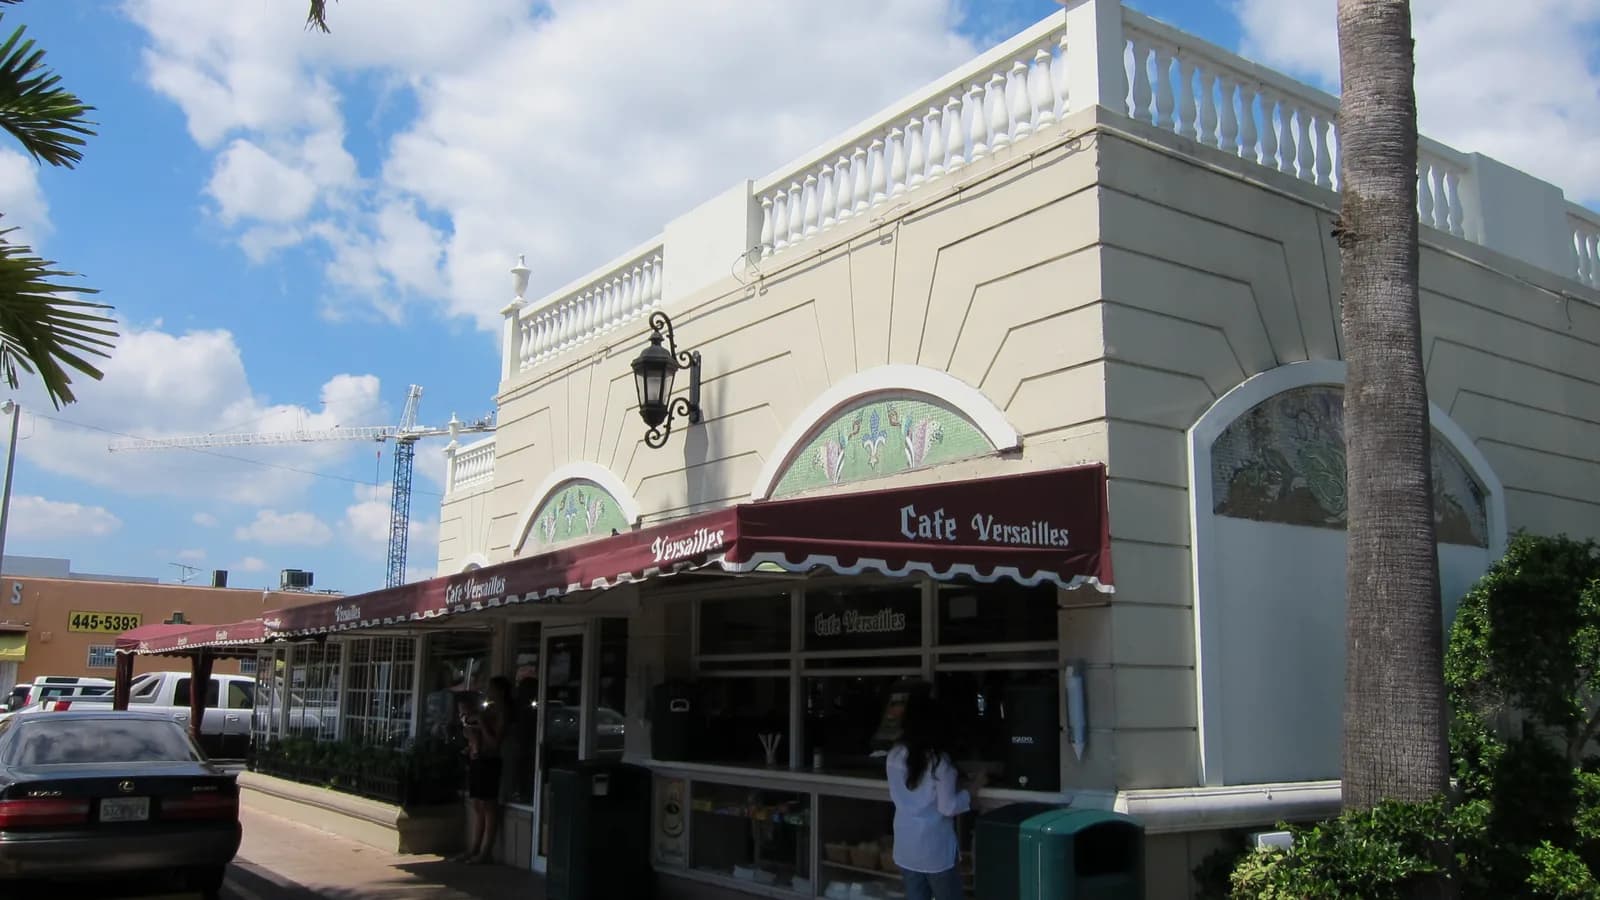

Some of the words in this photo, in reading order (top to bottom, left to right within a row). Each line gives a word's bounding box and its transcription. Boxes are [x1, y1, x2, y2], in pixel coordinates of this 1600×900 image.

[900, 504, 957, 540] Cafe
[971, 512, 1069, 547] Versailles
[651, 528, 724, 562] Versailles
[11, 582, 23, 605] S
[446, 582, 462, 604] Cafe
[464, 576, 506, 599] Versailles
[72, 613, 138, 631] 445-5393
[815, 612, 840, 636] Cafe
[842, 607, 905, 633] Versailles
